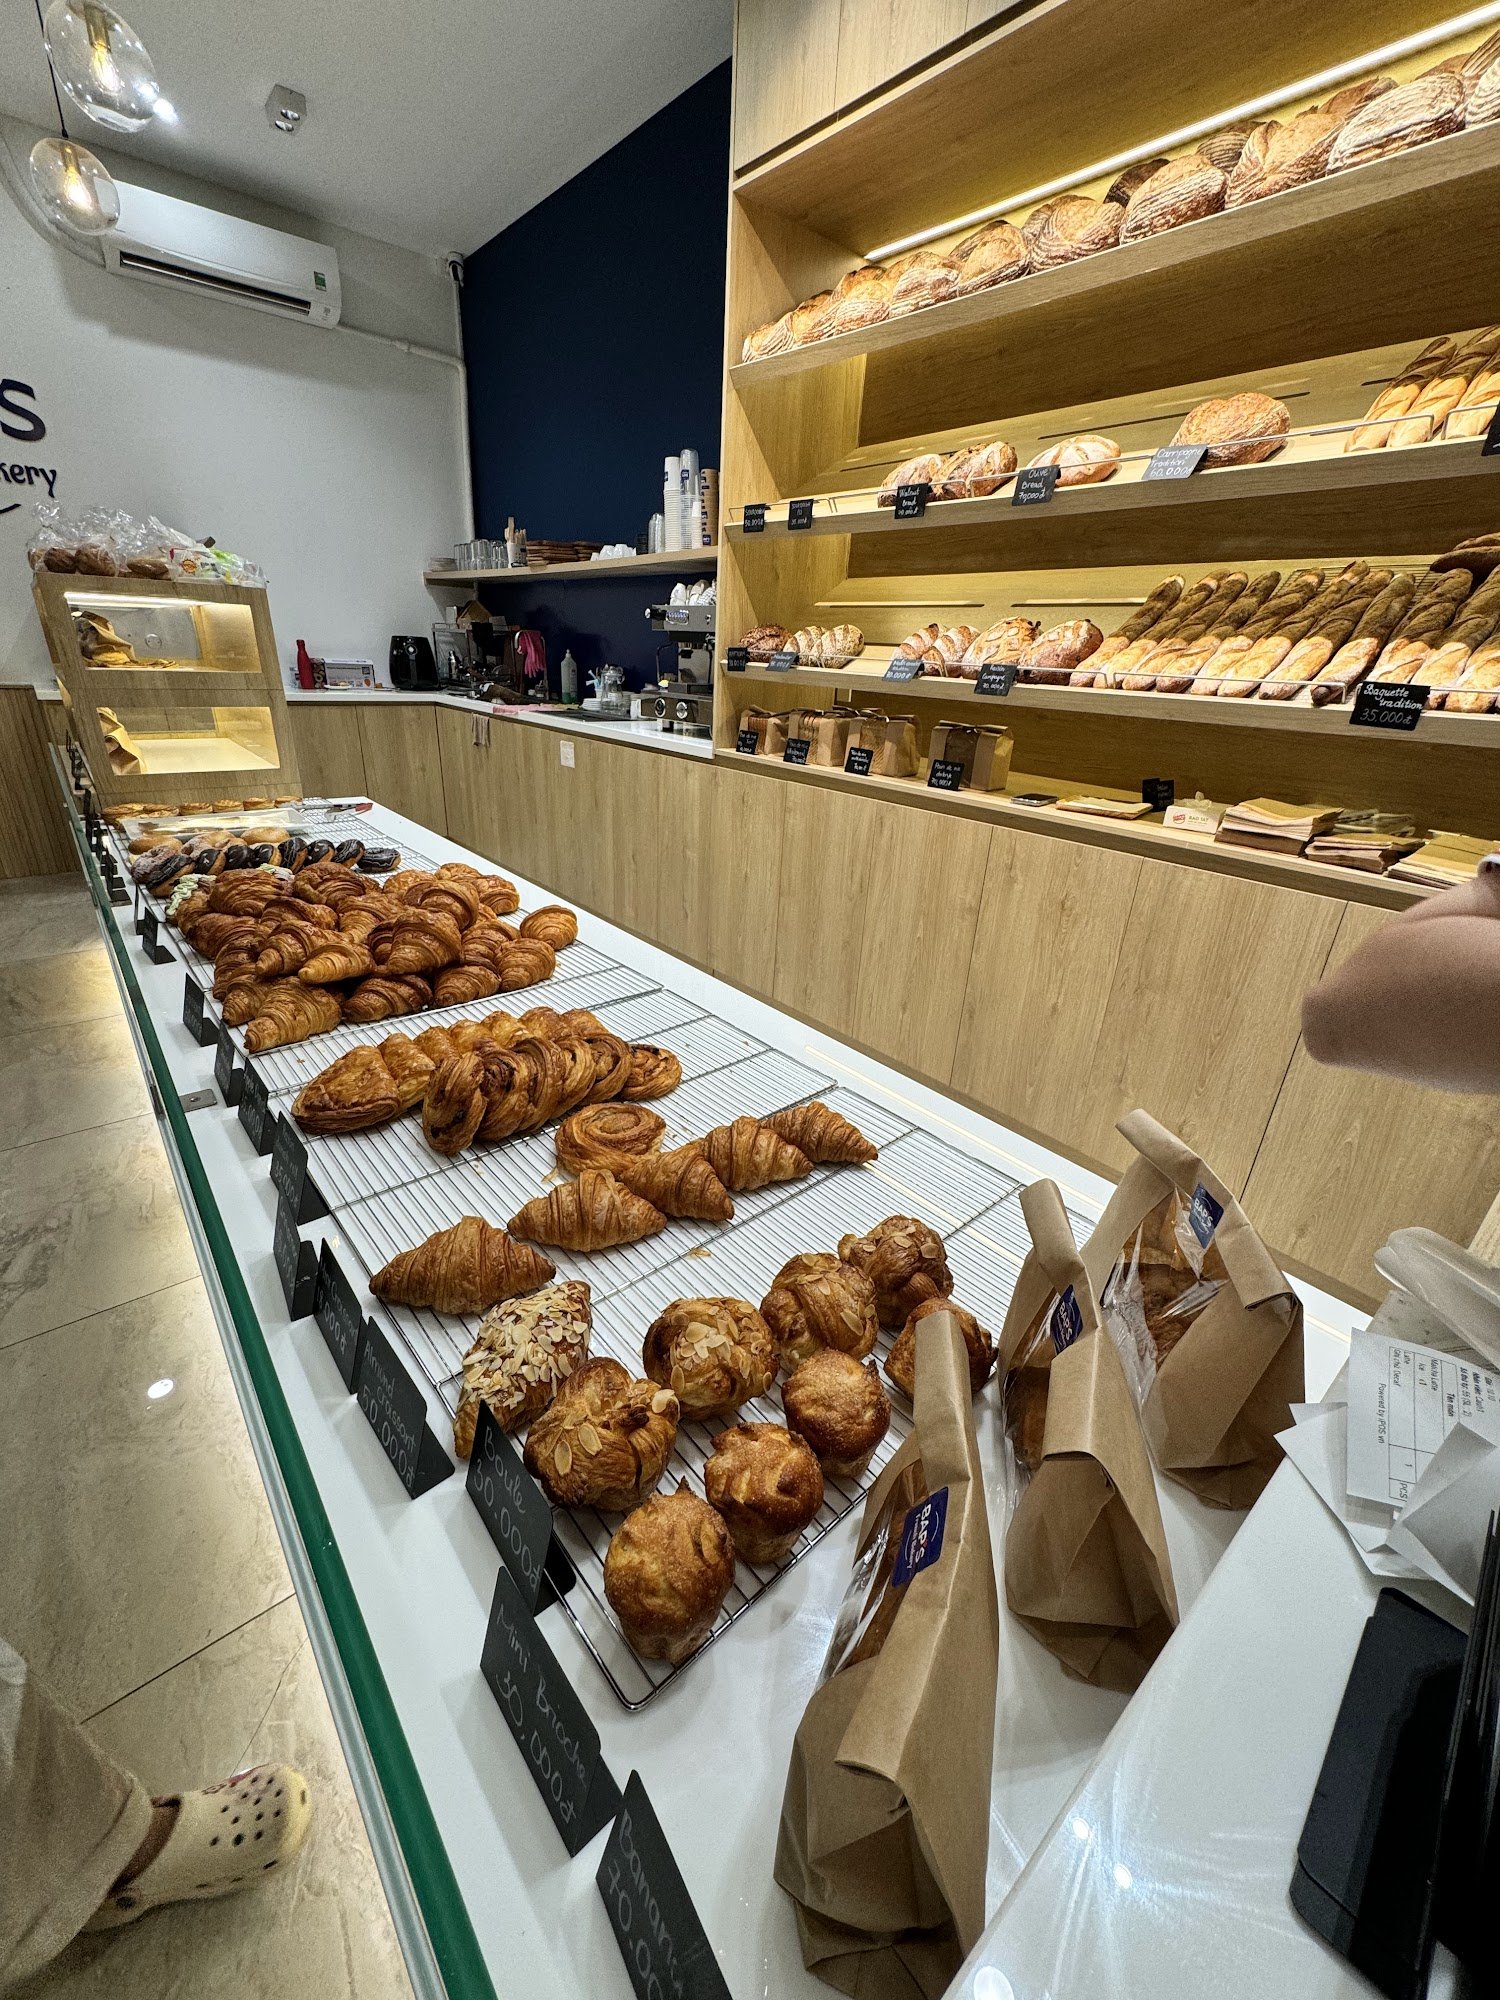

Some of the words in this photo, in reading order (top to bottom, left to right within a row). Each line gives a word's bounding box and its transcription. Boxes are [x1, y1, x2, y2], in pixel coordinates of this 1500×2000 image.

[1028, 468, 1049, 478] Olive
[1021, 478, 1043, 490] Bread
[1364, 684, 1410, 700] Baguette
[1380, 698, 1423, 710] tradition
[1360, 708, 1412, 724] 35.000đ
[1378, 1382, 1386, 1409] Powered
[1376, 1410, 1385, 1418] by
[484, 1426, 526, 1514] Boule
[474, 1458, 540, 1592] 30.000đ
[916, 1504, 932, 1563] BAP'S
[497, 1603, 530, 1673] Mini
